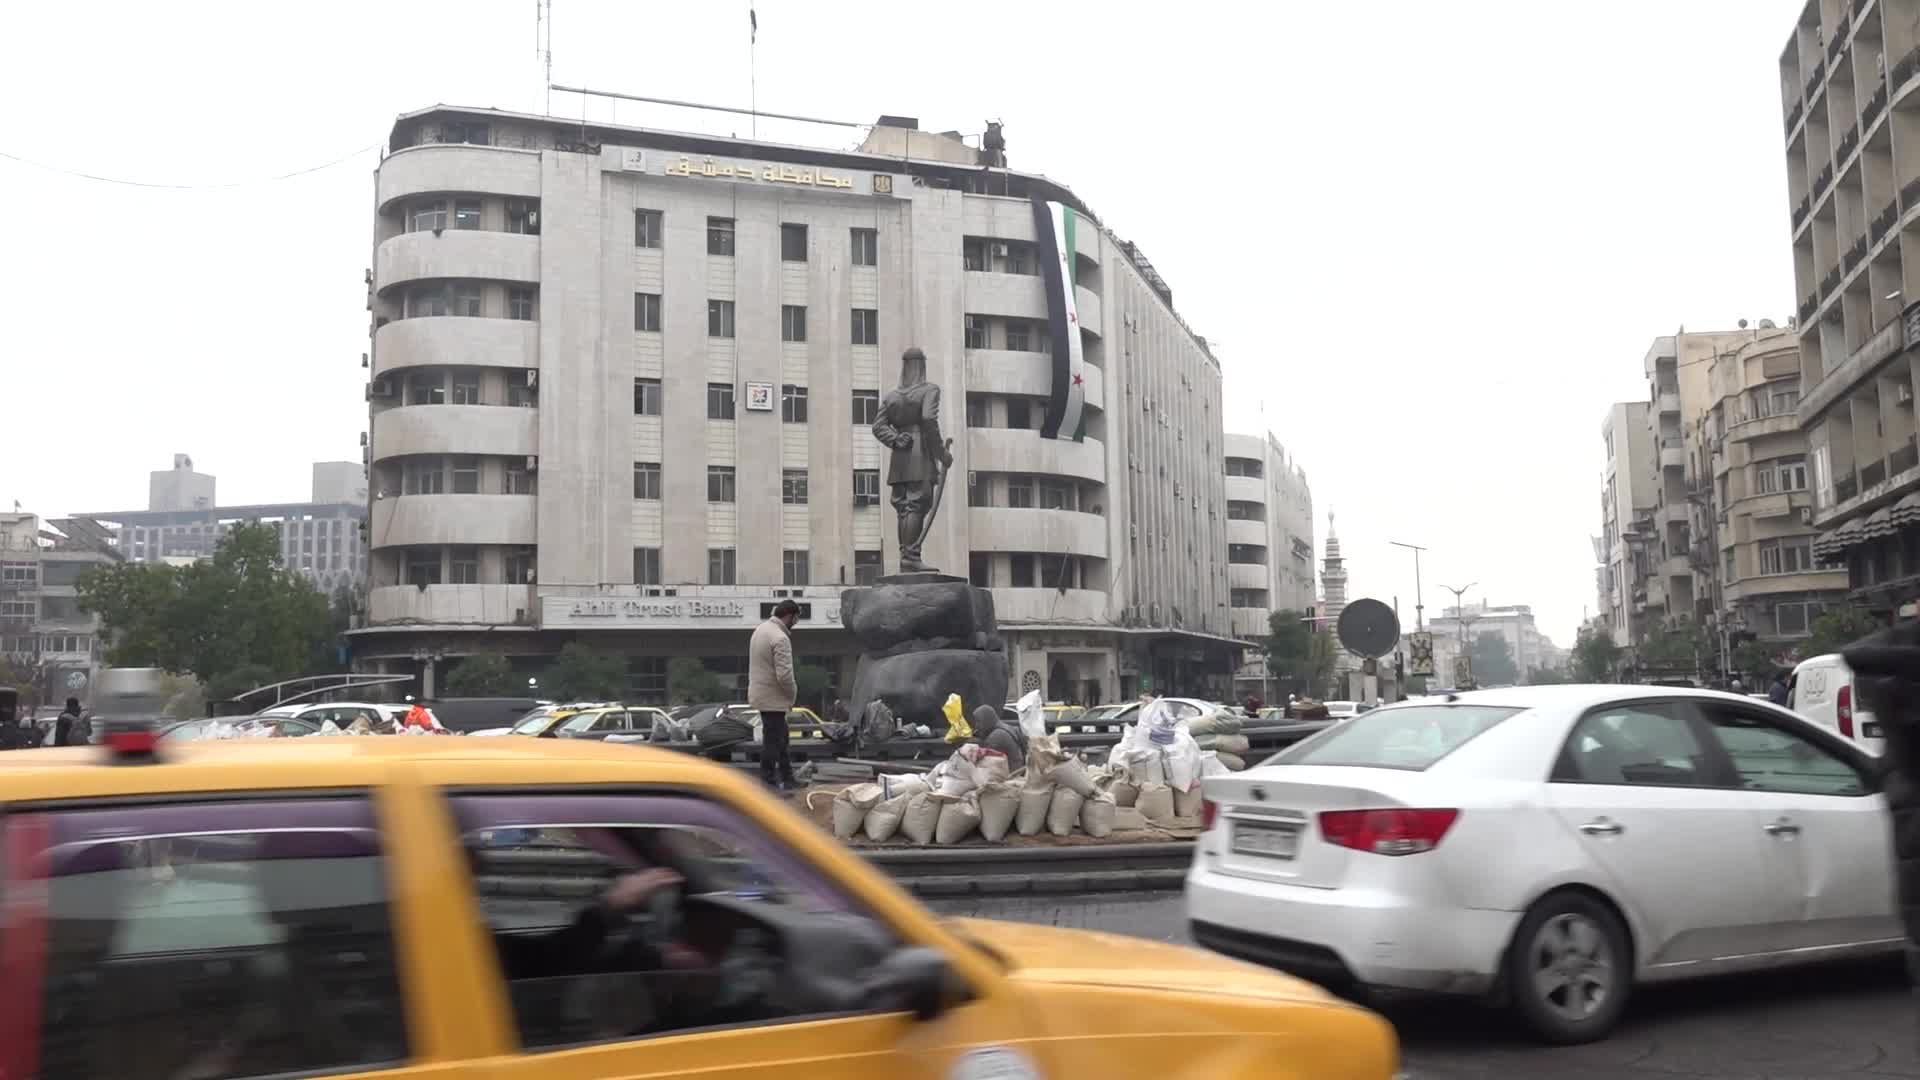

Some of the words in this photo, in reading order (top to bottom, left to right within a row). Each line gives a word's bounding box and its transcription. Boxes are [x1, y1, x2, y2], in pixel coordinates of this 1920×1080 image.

[665, 155, 754, 180] دمشق
[763, 164, 853, 188] محافظة
[569, 600, 617, 618] Ahli
[623, 600, 681, 618] Trust
[688, 600, 745, 618] Bank
